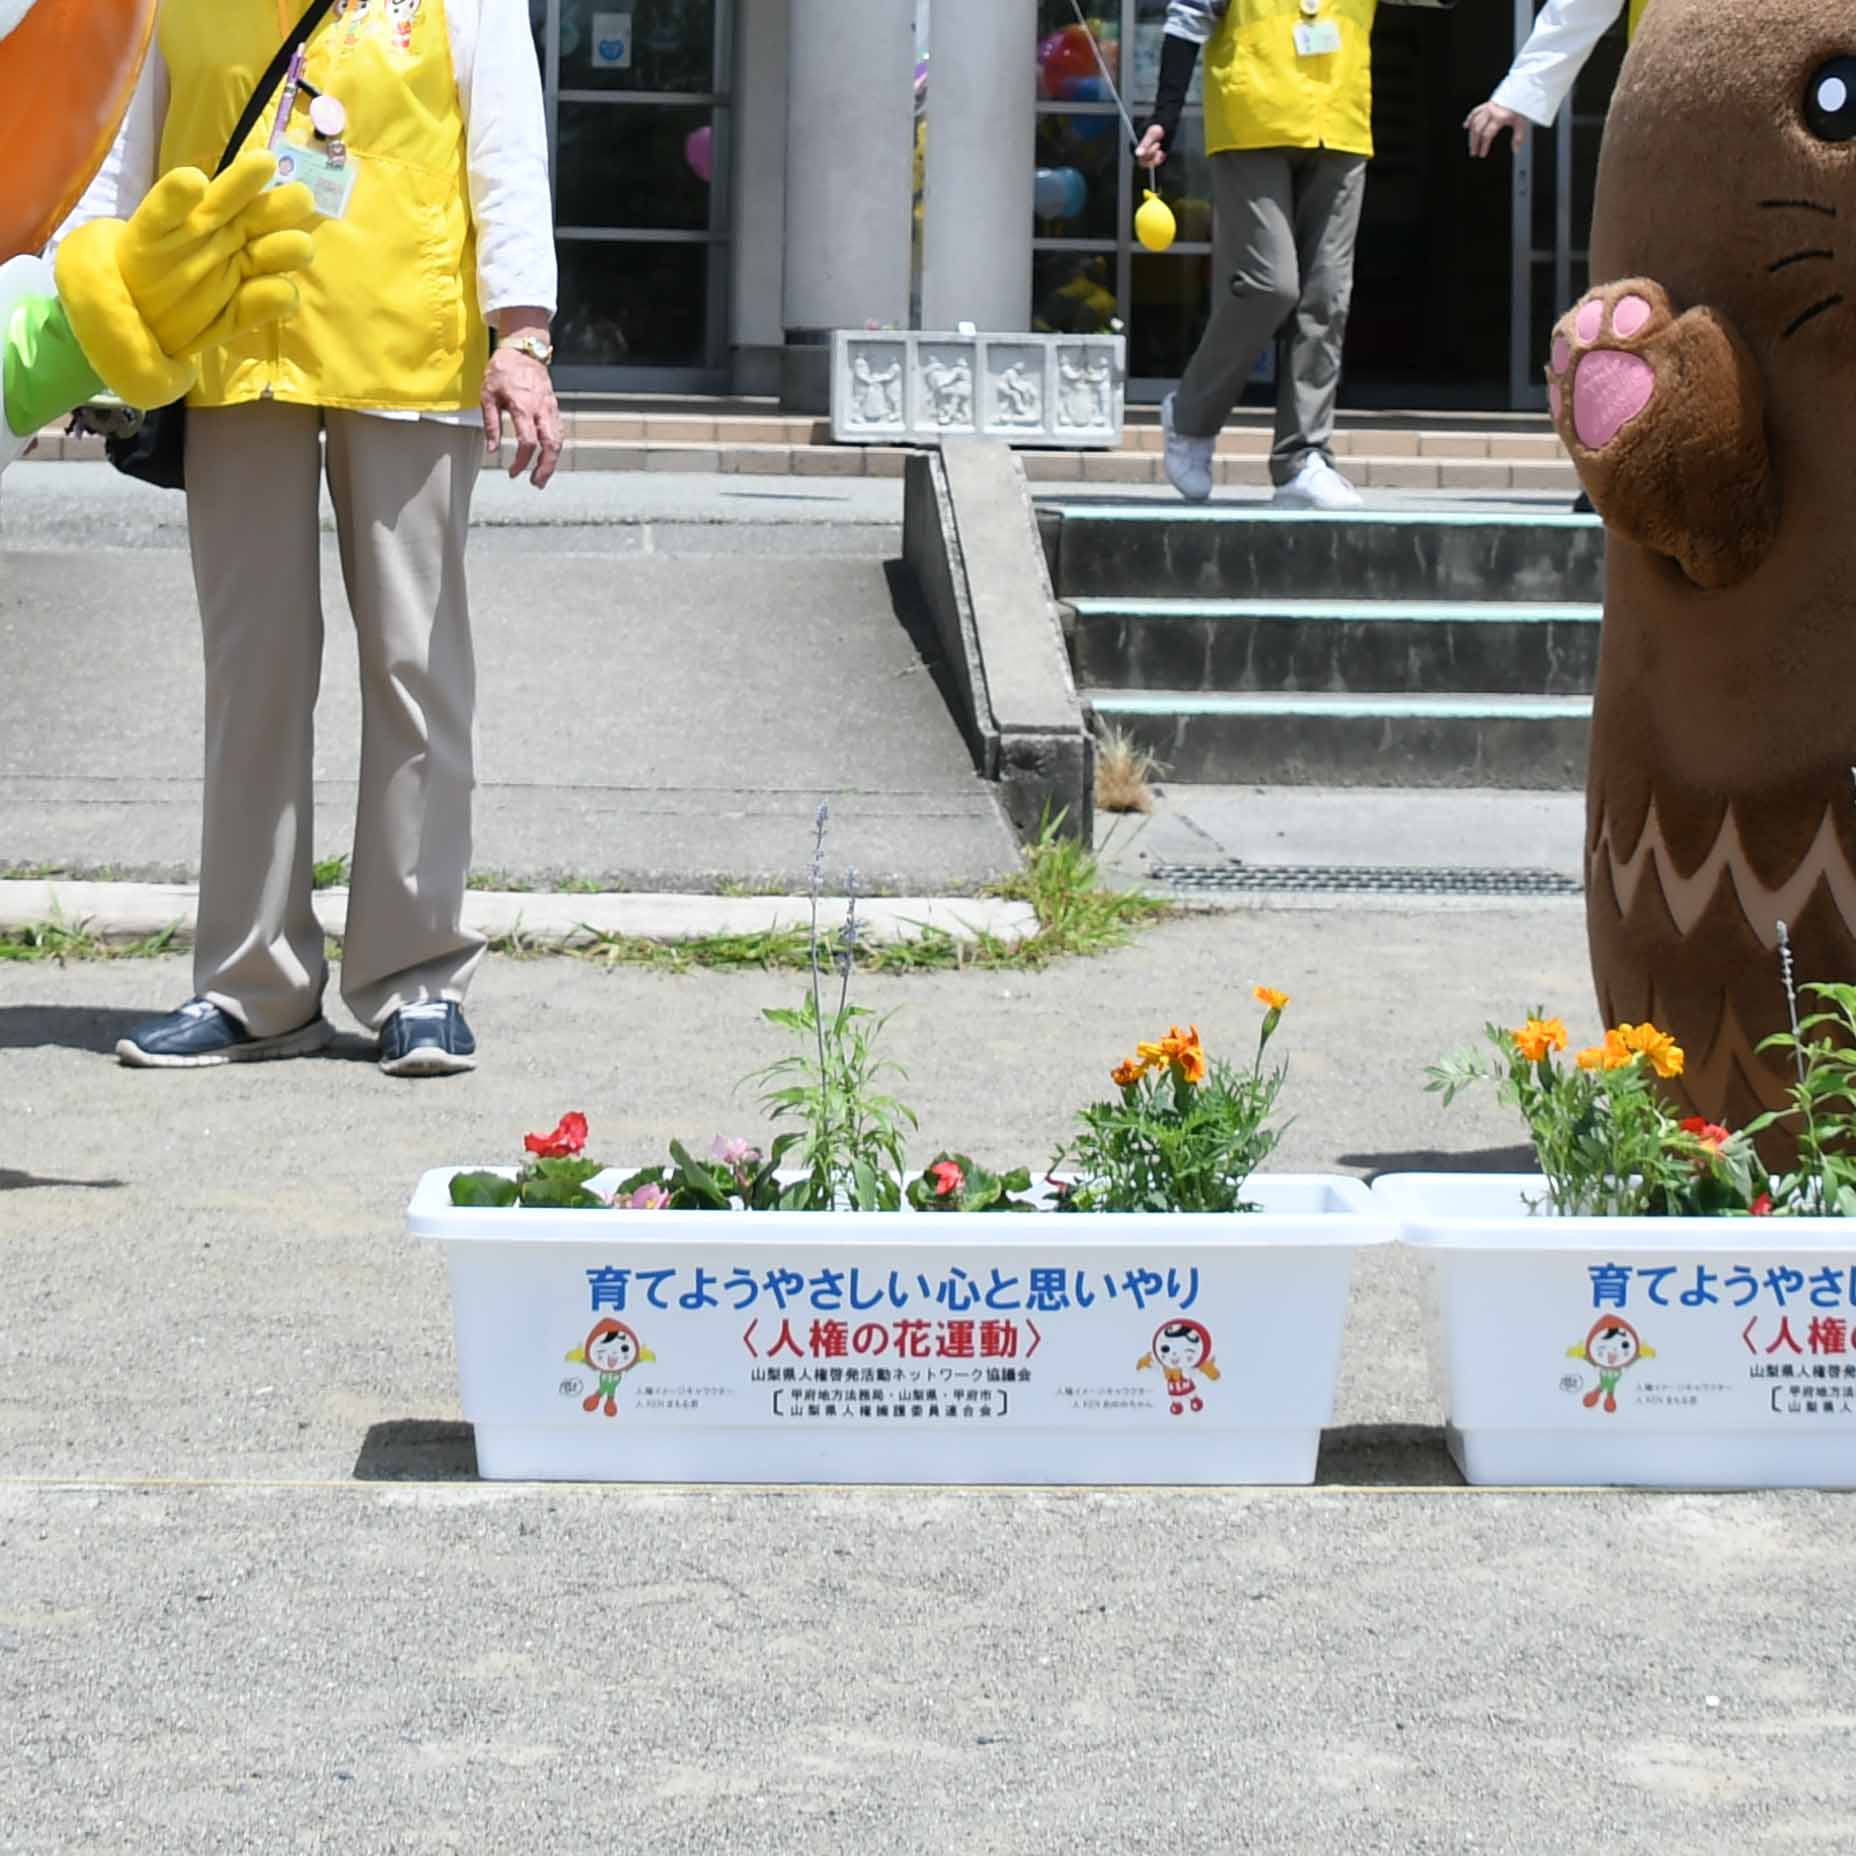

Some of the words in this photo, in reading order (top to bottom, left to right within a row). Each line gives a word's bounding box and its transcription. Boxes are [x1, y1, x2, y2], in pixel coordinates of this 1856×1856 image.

[584, 1265, 1200, 1312] 育てようやさしい心と思いやり
